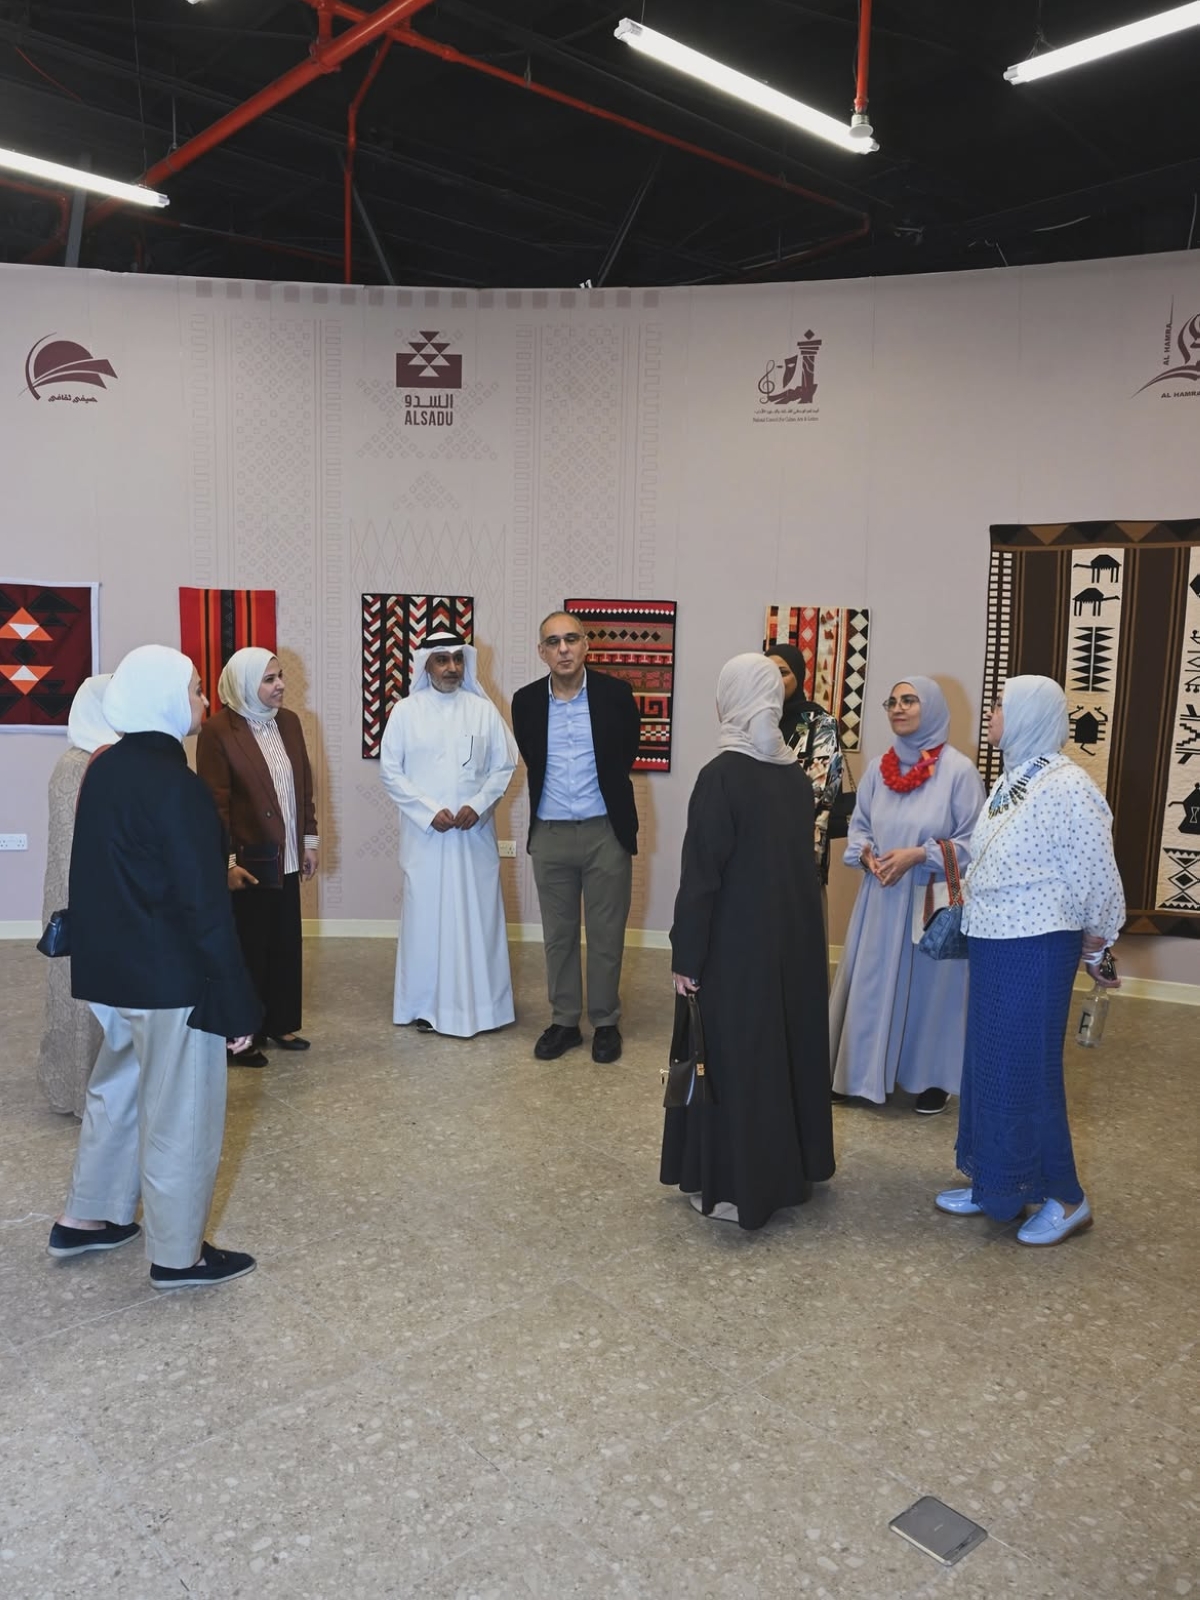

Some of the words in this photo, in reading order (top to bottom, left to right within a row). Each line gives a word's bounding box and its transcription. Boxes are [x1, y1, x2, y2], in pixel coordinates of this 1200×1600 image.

[1164, 322, 1172, 353] HAMRA
[1163, 355, 1170, 366] AL
[404, 393, 453, 409] السدو
[404, 410, 453, 426] ALSADU
